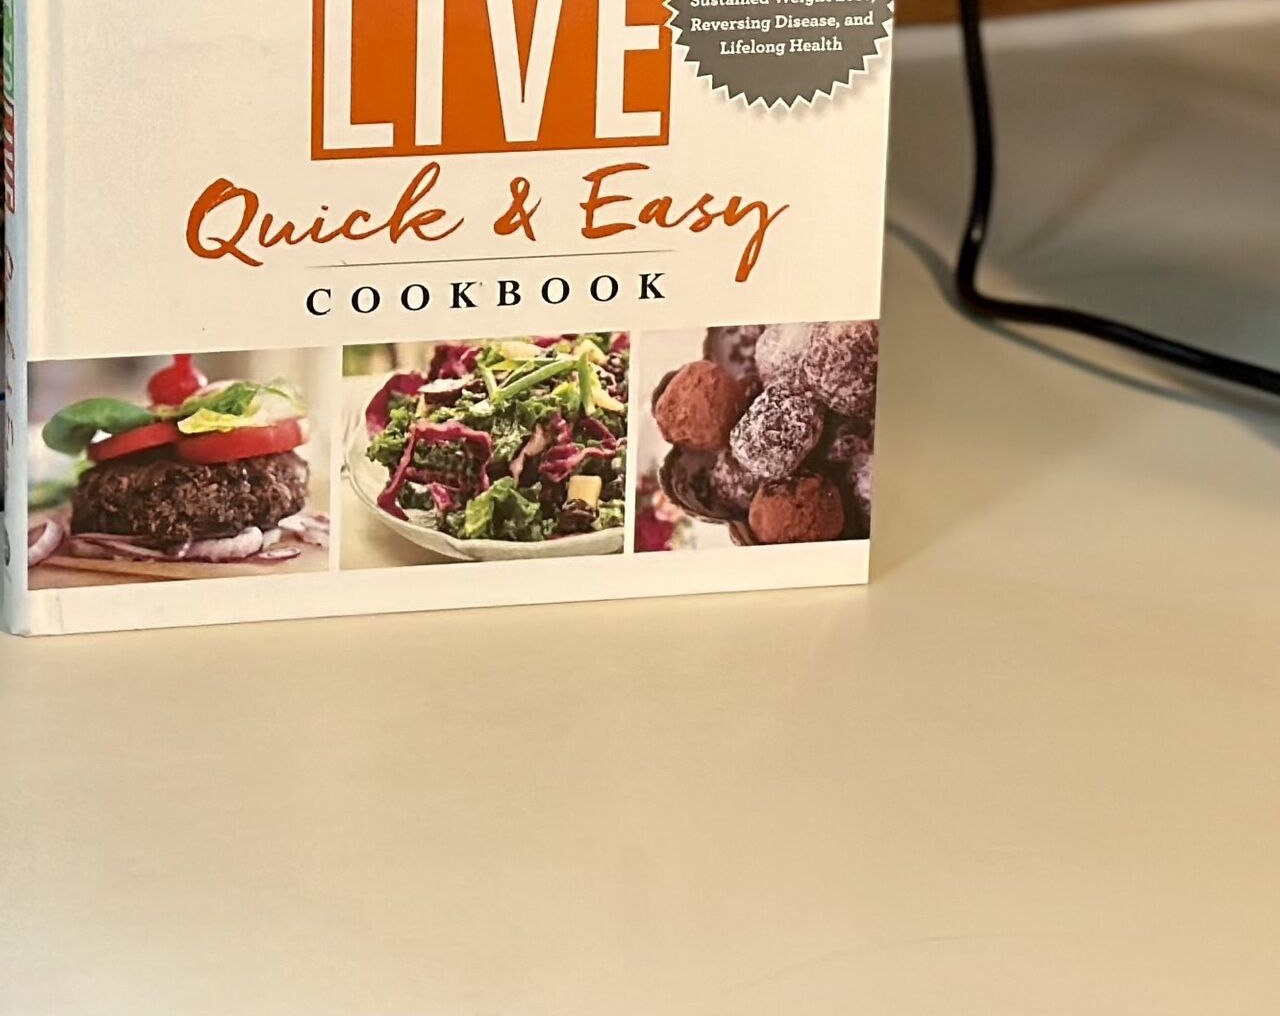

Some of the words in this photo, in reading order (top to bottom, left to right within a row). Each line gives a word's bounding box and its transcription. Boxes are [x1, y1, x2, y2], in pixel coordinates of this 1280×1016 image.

[690, 16, 771, 32] Reversing
[775, 14, 840, 29] Disease,
[844, 11, 874, 26] and
[720, 40, 785, 56] Lifelong
[789, 36, 842, 52] Health
[186, 161, 465, 266] Quick
[492, 176, 542, 242] &
[579, 161, 790, 283] Easy
[306, 272, 666, 316] COOKBOOK
